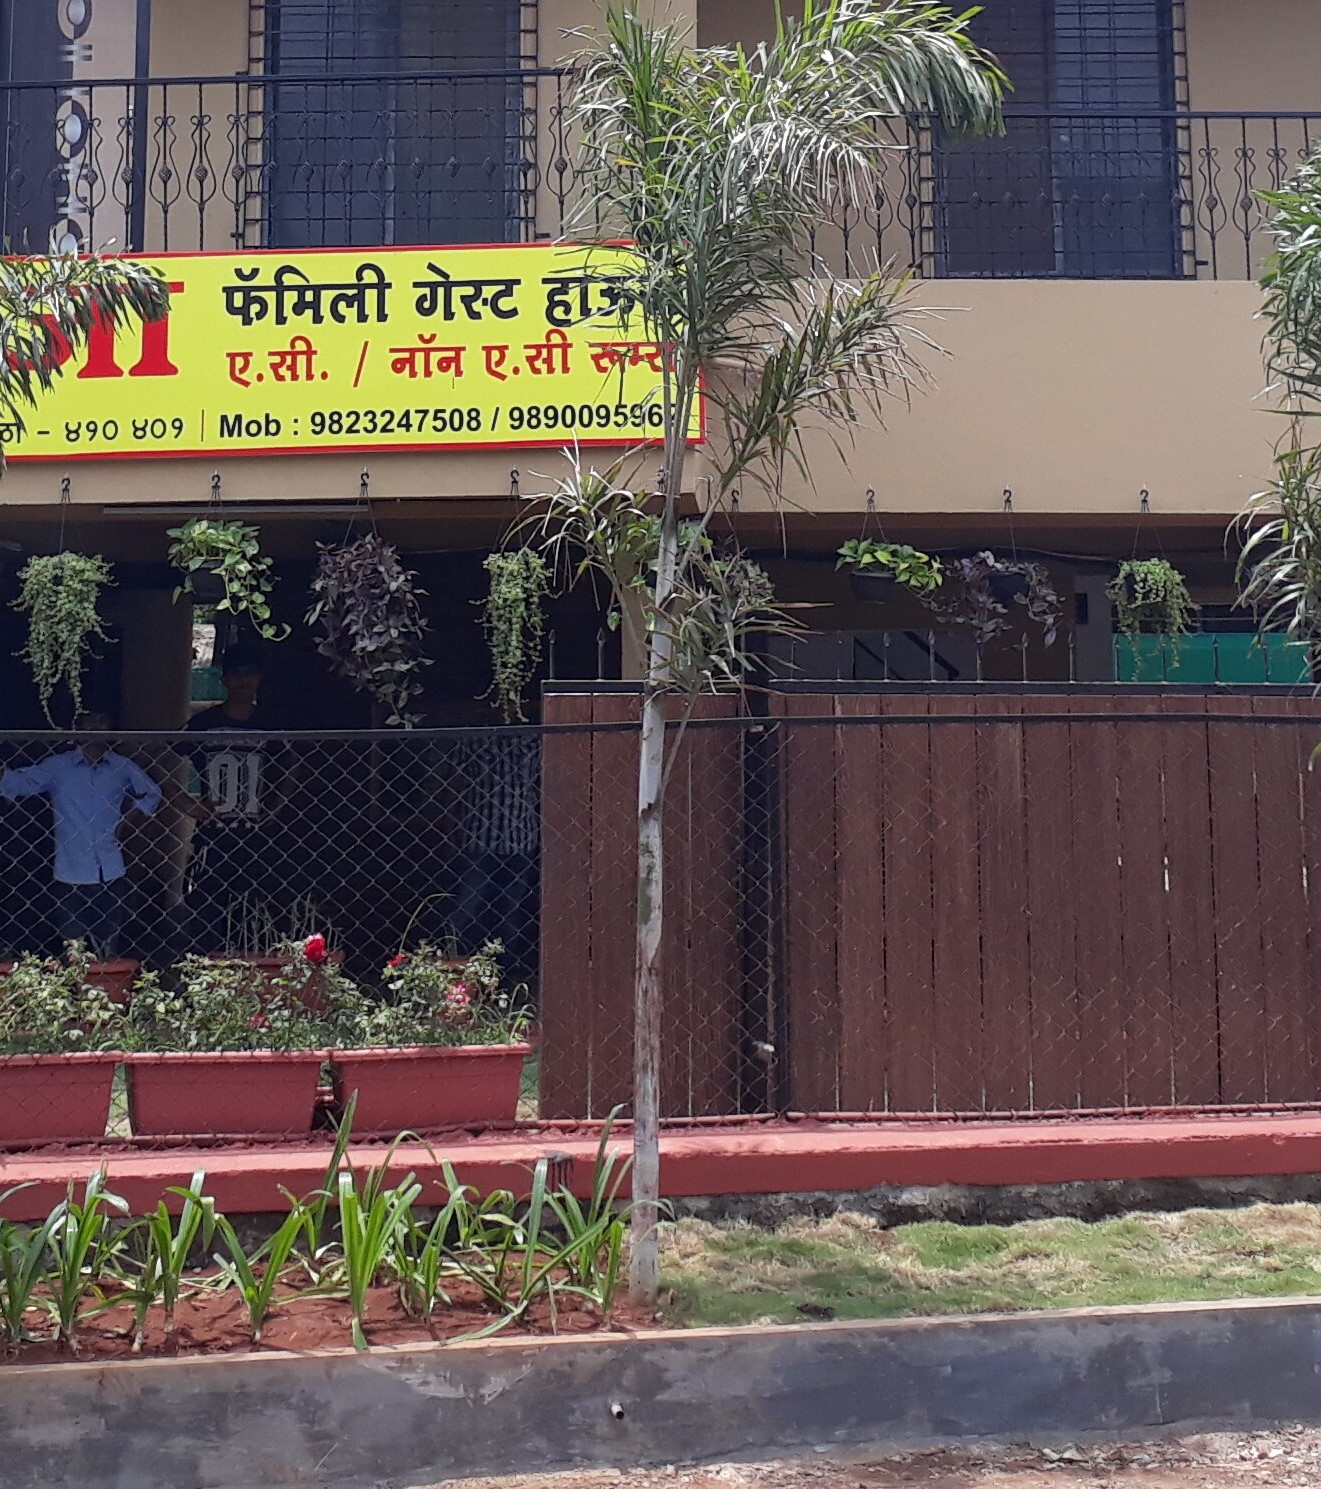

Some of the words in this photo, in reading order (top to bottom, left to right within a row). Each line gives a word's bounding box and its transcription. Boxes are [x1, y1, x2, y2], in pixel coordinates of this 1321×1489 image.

[222, 262, 393, 327] फॅमिली
[412, 261, 522, 321] गेस्ट
[541, 276, 682, 328] हाऊ
[226, 335, 329, 388] ए.सी.
[352, 340, 370, 388] /
[388, 333, 467, 379] नॉन
[481, 328, 573, 382] ए.सी
[219, 413, 282, 439] Mob
[293, 418, 300, 436] :
[310, 407, 482, 436] 9823247508
[490, 406, 500, 432] /
